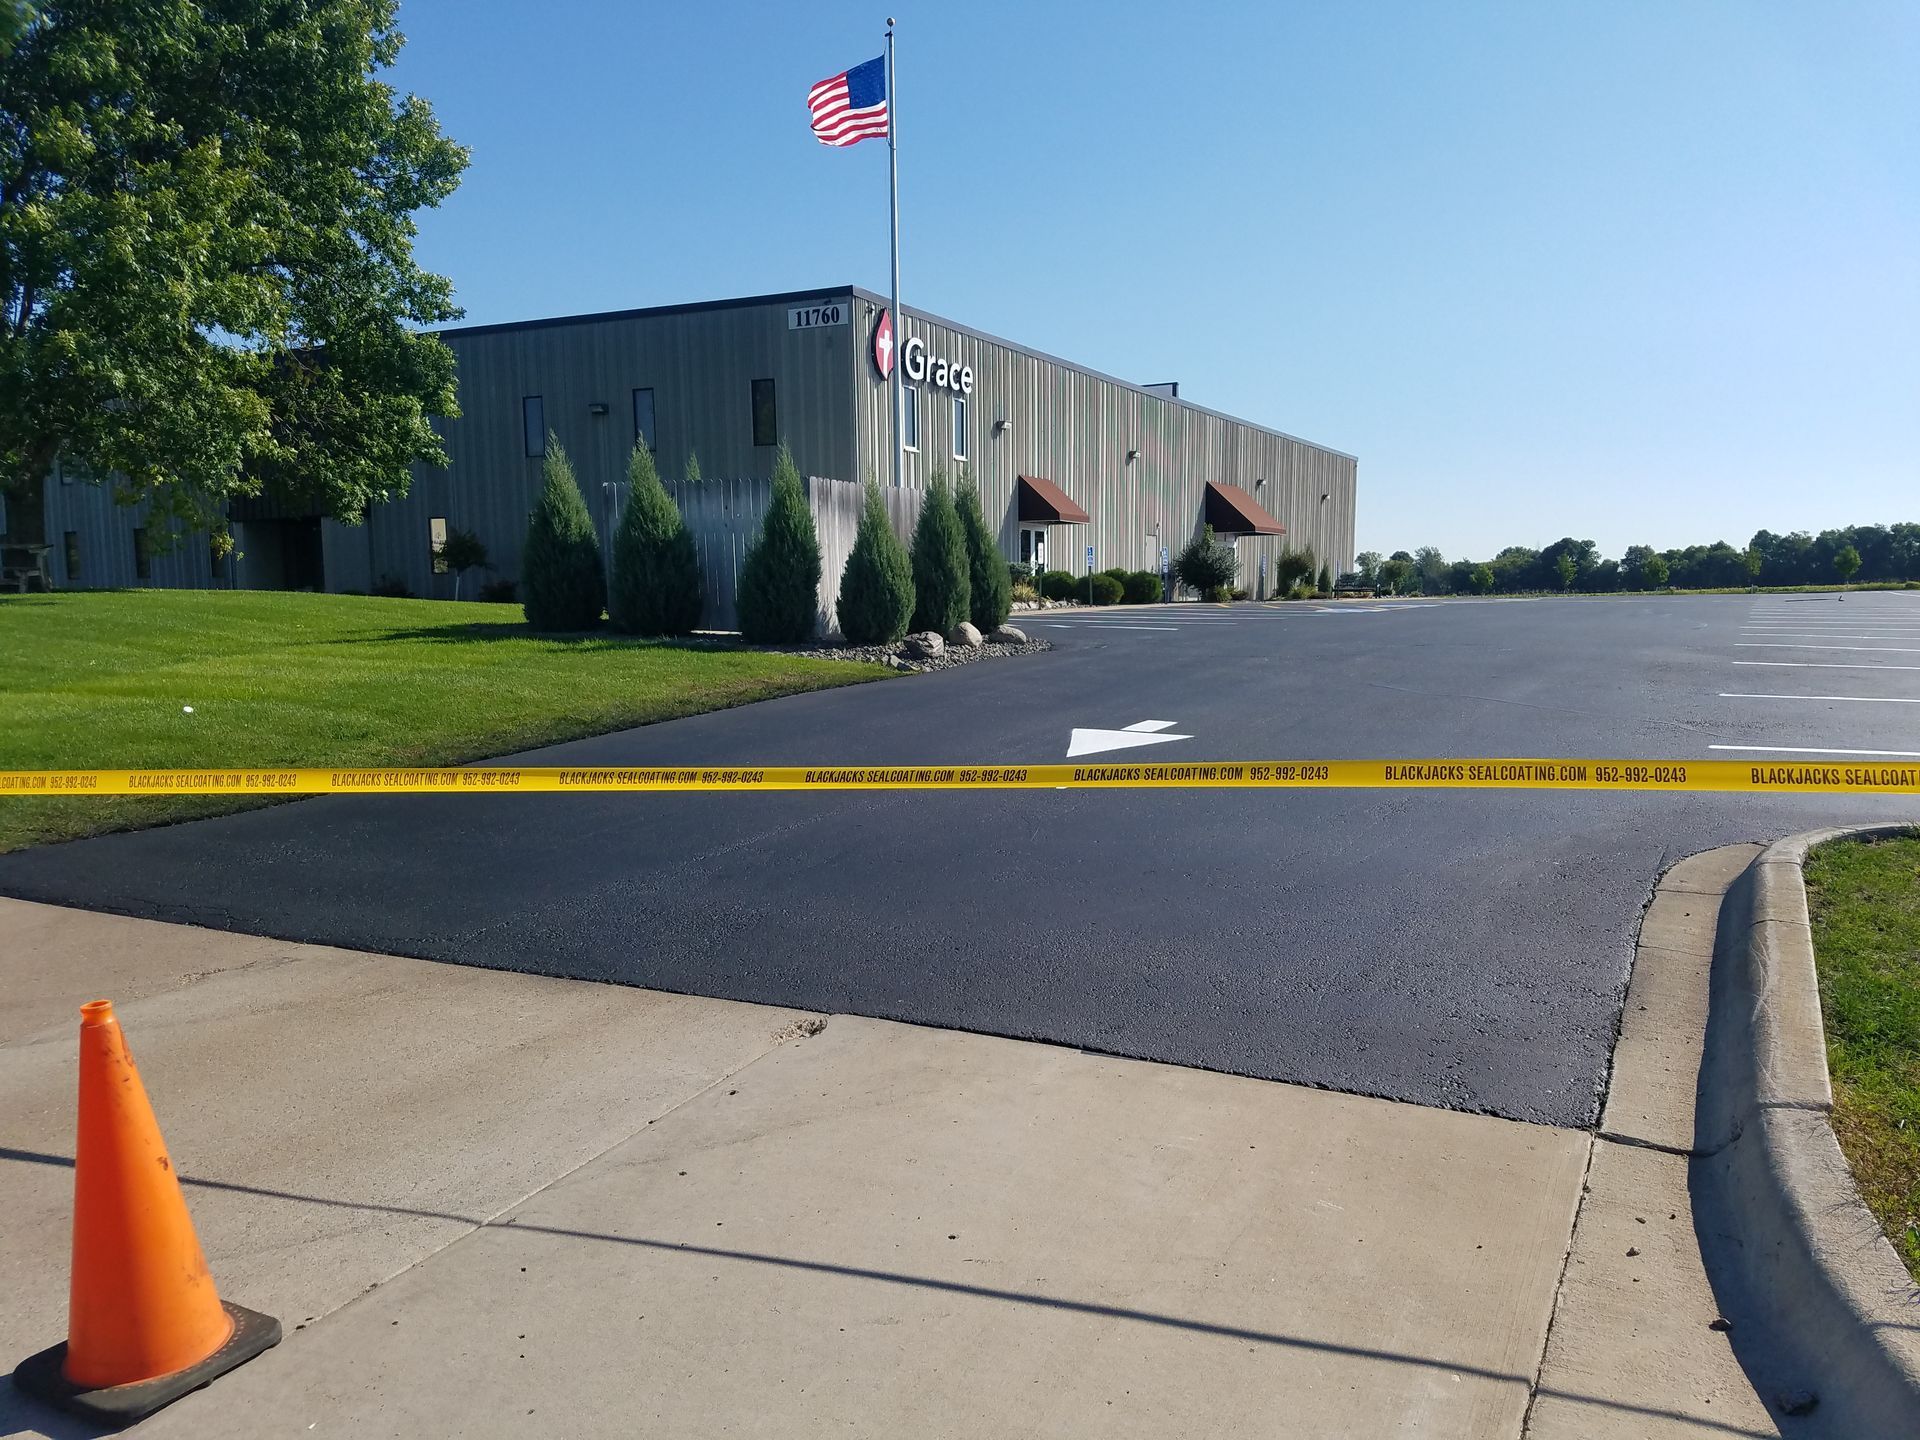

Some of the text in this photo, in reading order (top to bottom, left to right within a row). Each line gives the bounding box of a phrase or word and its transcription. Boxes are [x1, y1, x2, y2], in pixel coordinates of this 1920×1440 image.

[795, 306, 840, 327] 11760
[905, 337, 973, 394] Grace
[128, 774, 297, 788] BLACKJACKS SEALCOATING.COM 952-992-0243
[331, 772, 520, 787] BLACKJACKS SEALCOATING.COM 952-992-0243
[559, 771, 763, 785] BLACKJACKS SEALCOATING.COM 952-992-0243
[805, 769, 1028, 783] BLACKJACKS SEALCOATING.COM 952-992-0243
[1073, 766, 1329, 781] BLACKJACKS SEALCOATING.COM 952-992-0243
[1385, 765, 1687, 783] BLACKJACKS SEALCOATING.COM 952-992-0243
[1751, 767, 1840, 785] BLACKJACKS
[0, 776, 97, 788] COATING.COM 952-992-0243
